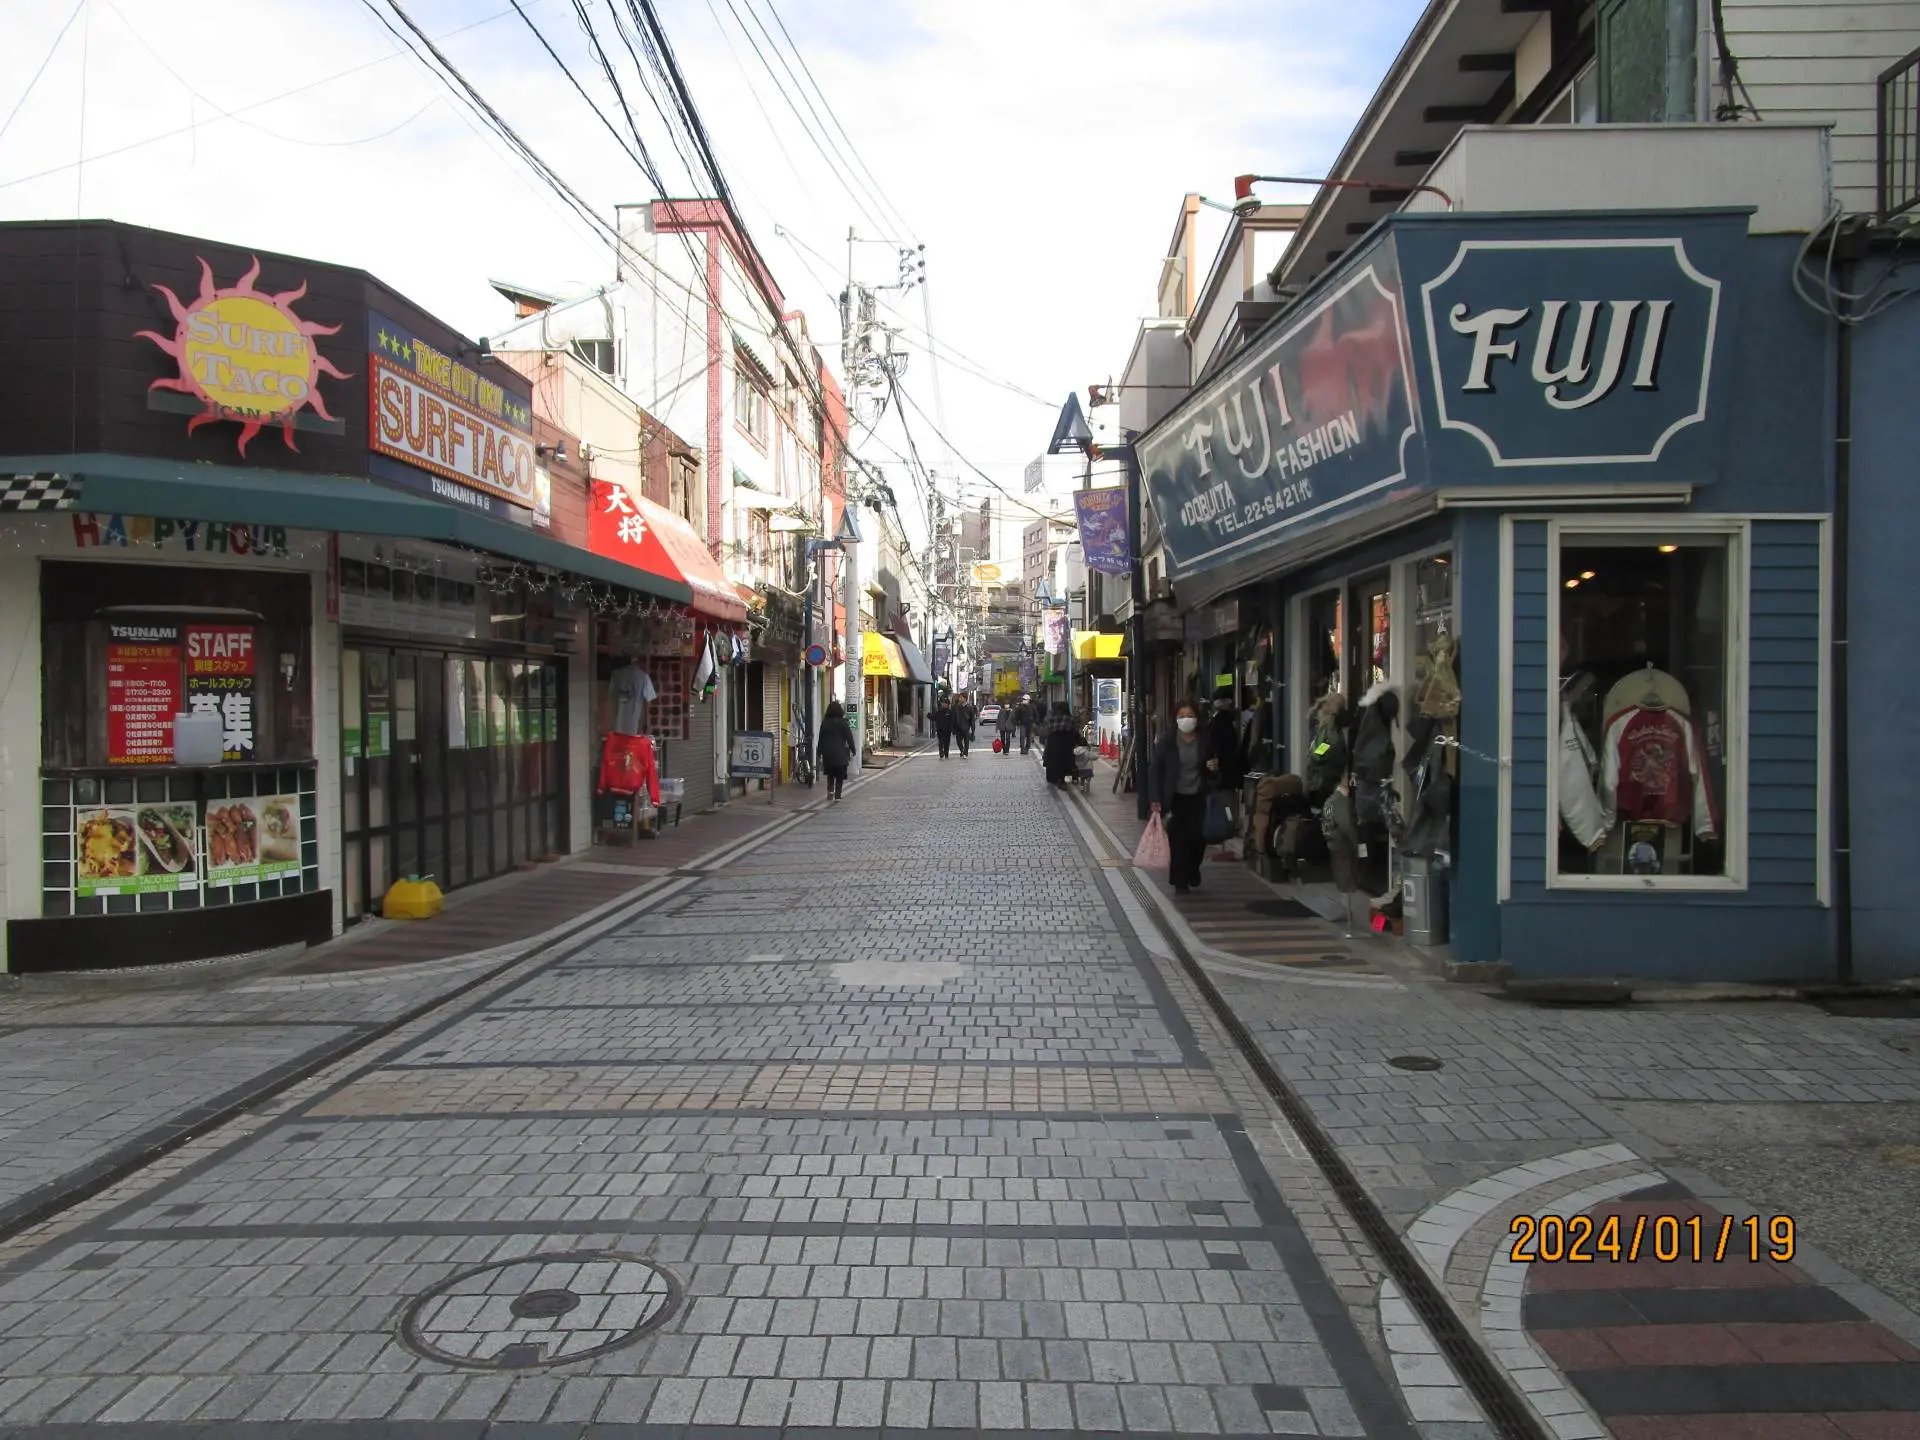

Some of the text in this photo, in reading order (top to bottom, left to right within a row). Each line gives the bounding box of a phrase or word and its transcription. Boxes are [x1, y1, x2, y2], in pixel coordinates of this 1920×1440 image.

[186, 310, 308, 359] SURF
[1449, 300, 1673, 410] FUJI
[193, 351, 310, 401] TACO
[413, 338, 451, 388] TAKE
[451, 361, 479, 404] OUT
[1182, 362, 1292, 479] FUJI
[1276, 409, 1361, 481] FASHION
[603, 484, 647, 545] 大将
[1184, 479, 1236, 526] DOBUITA
[72, 511, 289, 558] HAPPY HOUR
[110, 624, 177, 639] TSUNAMI
[188, 632, 252, 658] STAFF
[189, 676, 252, 689] ホールスタッフ
[744, 748, 759, 761] 16
